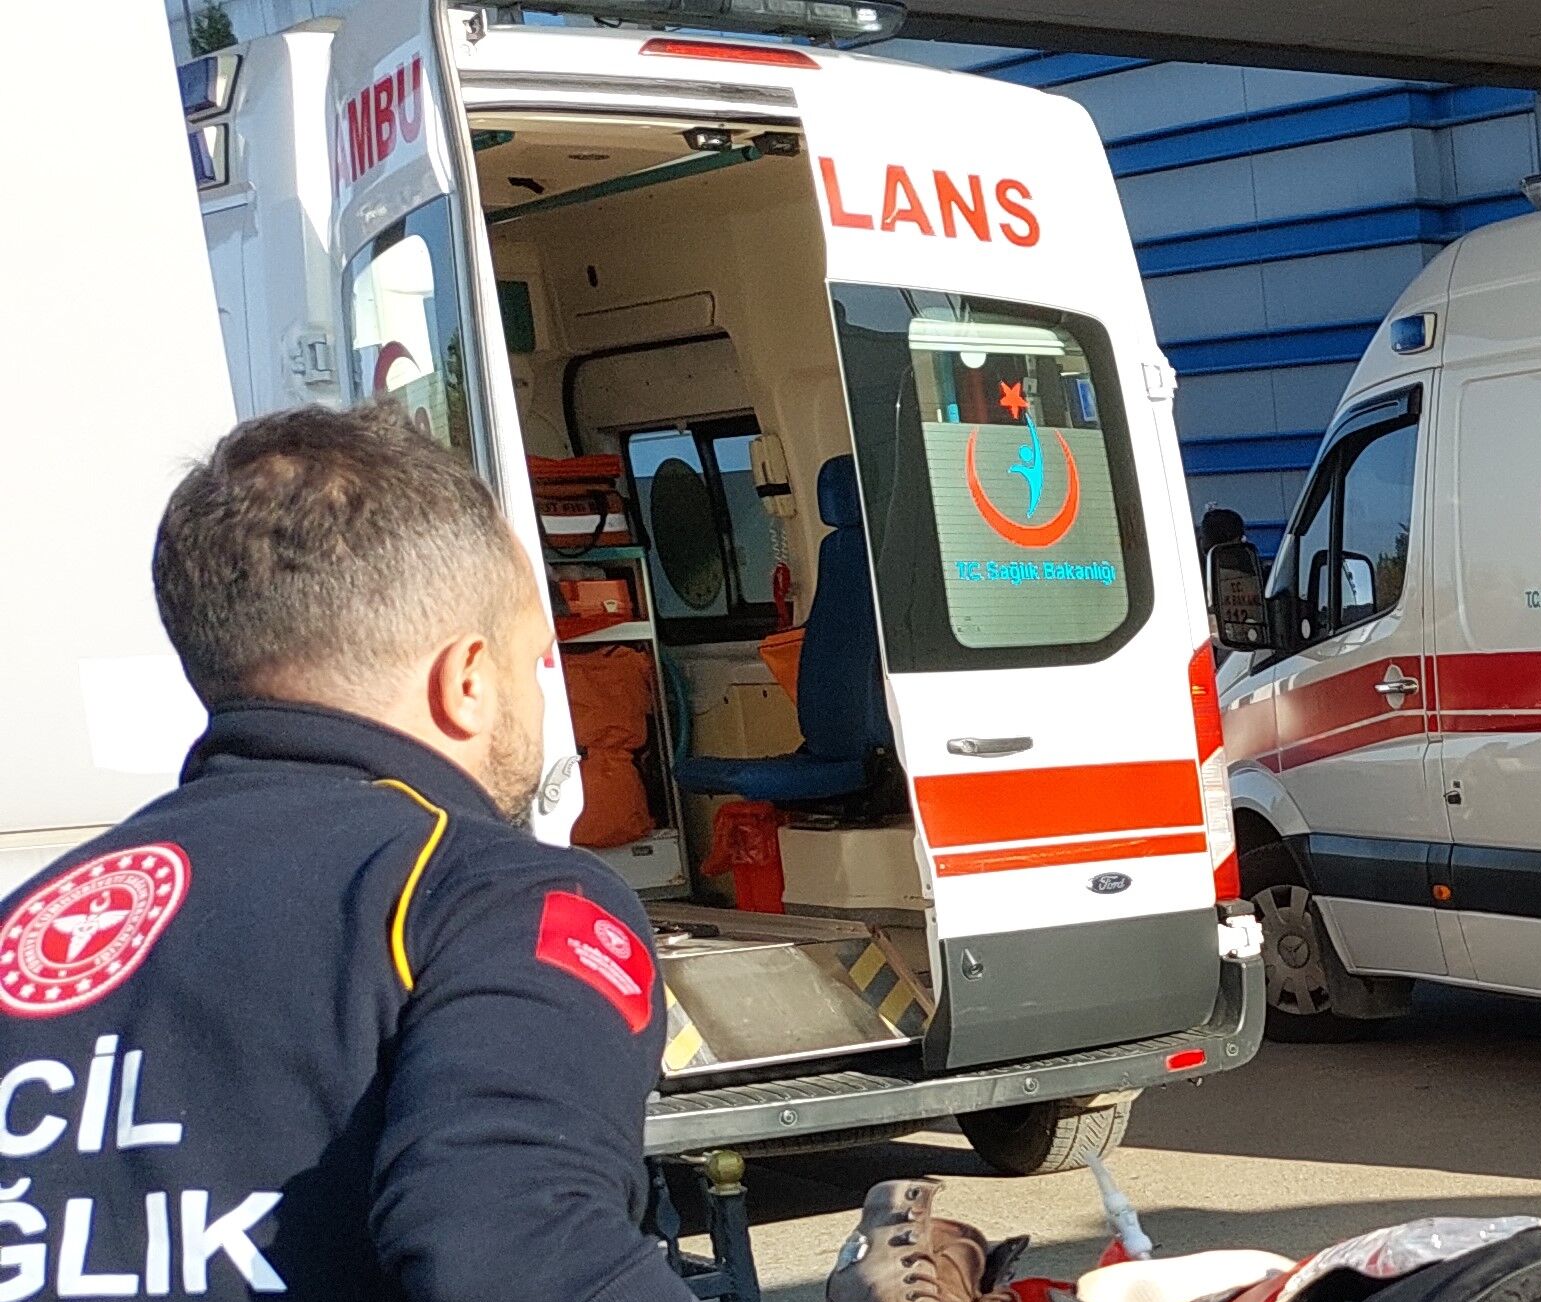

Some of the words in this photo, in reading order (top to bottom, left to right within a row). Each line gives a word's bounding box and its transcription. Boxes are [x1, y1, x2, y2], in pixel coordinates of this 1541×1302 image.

[818, 156, 1041, 247] LANS
[986, 560, 1040, 586] Sağlık
[1043, 560, 1117, 586] Bakanlığı
